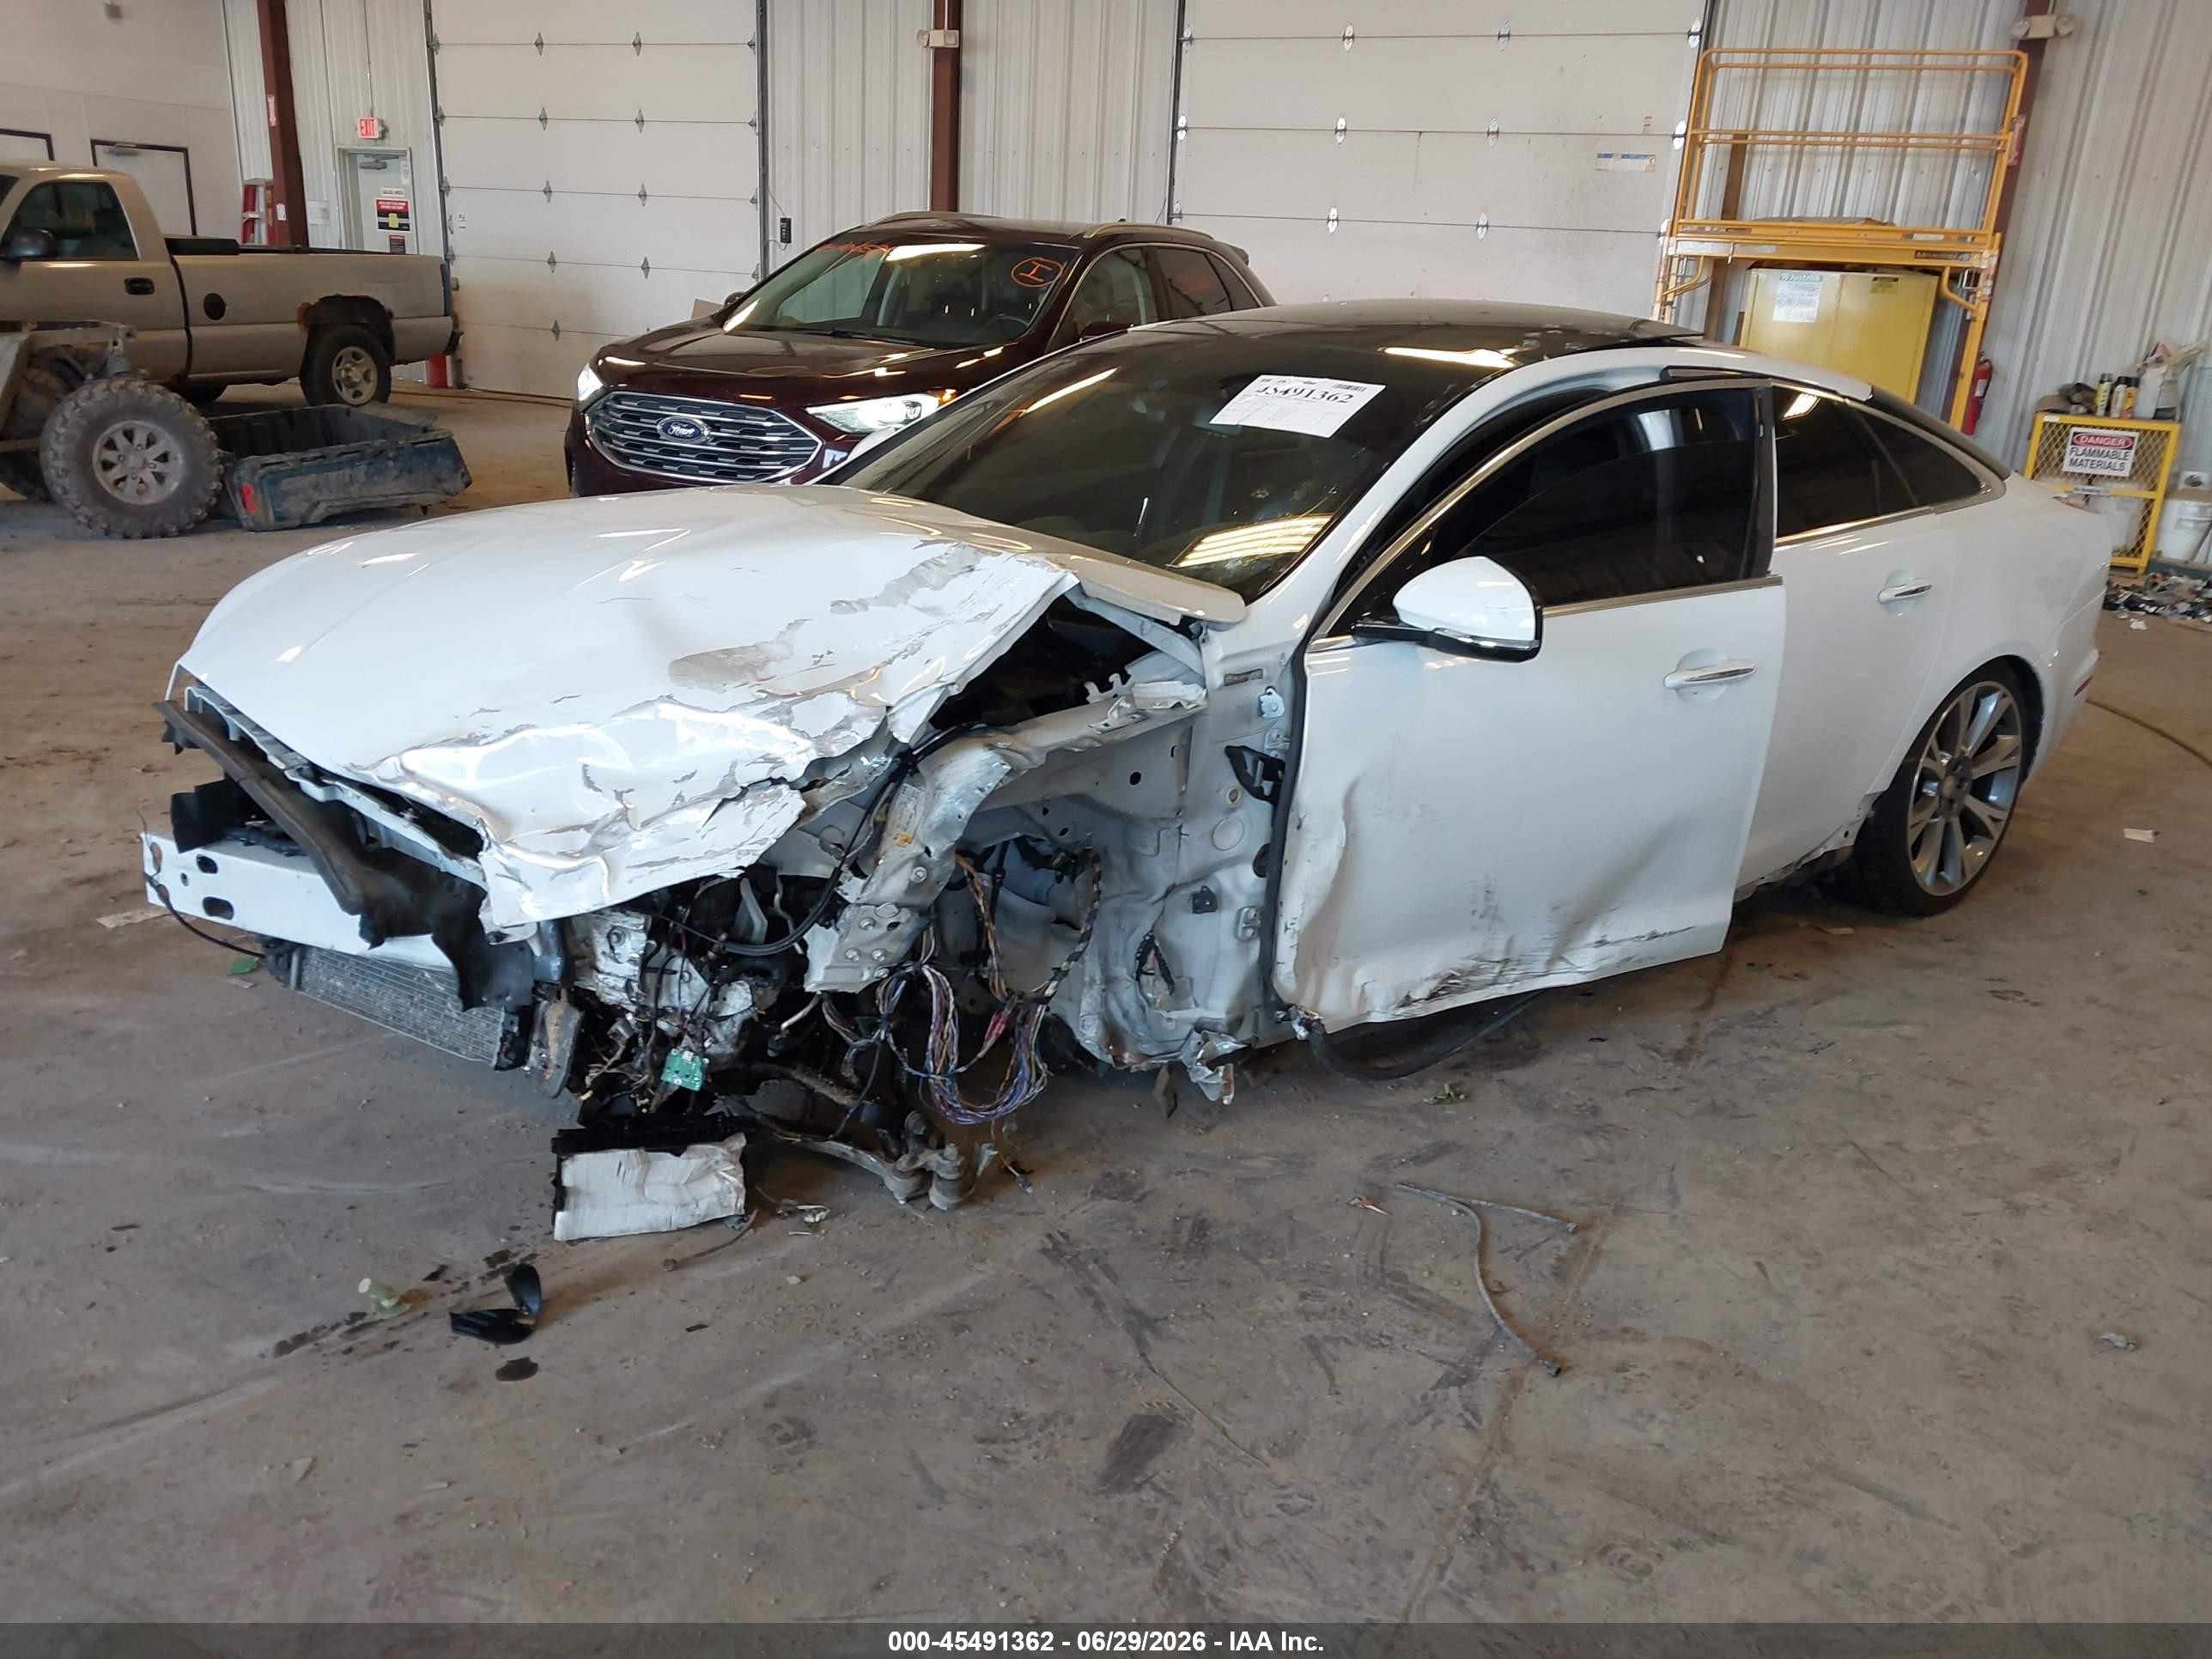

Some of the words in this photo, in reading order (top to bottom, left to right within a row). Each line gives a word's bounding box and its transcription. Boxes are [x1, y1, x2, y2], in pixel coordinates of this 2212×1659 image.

[667, 422, 696, 437] Ford
[2080, 435, 2126, 447] DANGER
[2069, 447, 2130, 461] FLAMMABLE
[2069, 458, 2126, 471] MATERIALS
